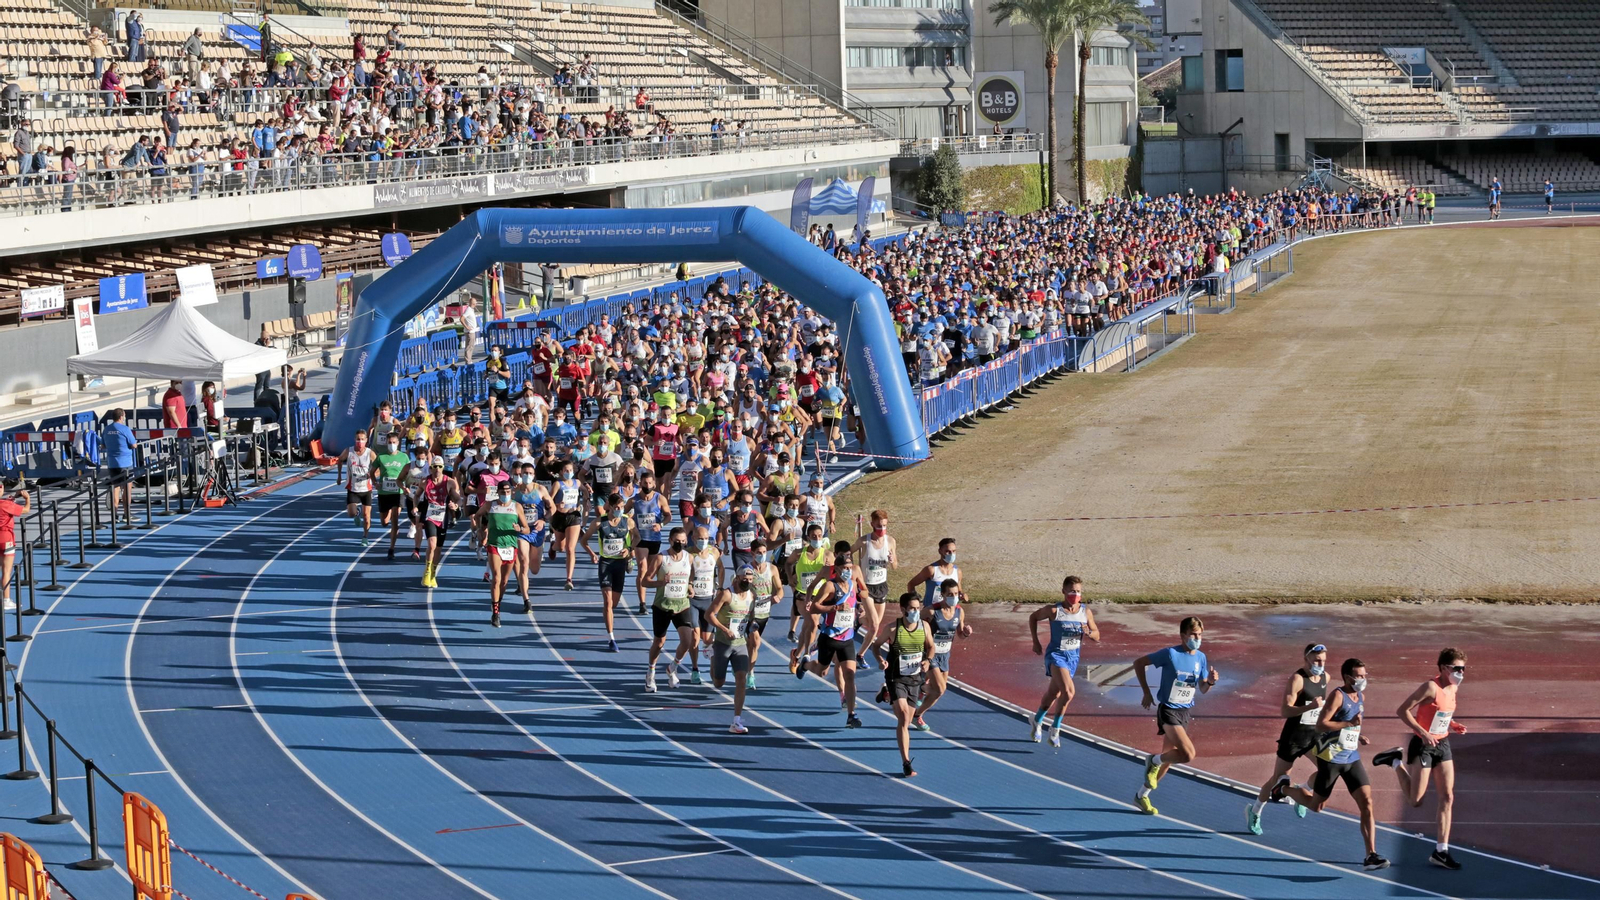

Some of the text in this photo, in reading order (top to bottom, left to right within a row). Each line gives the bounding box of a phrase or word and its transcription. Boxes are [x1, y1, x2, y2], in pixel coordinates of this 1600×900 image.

[981, 91, 1017, 107] B&B
[528, 225, 712, 238] Ayuntamiento de Jerez
[528, 237, 581, 245] Deportes
[347, 350, 368, 416] deportes@aytojerez.es
[862, 346, 887, 416] deportes@aytojerez.es
[669, 585, 683, 593] 830
[694, 582, 707, 590] 443
[1177, 690, 1190, 698] 788
